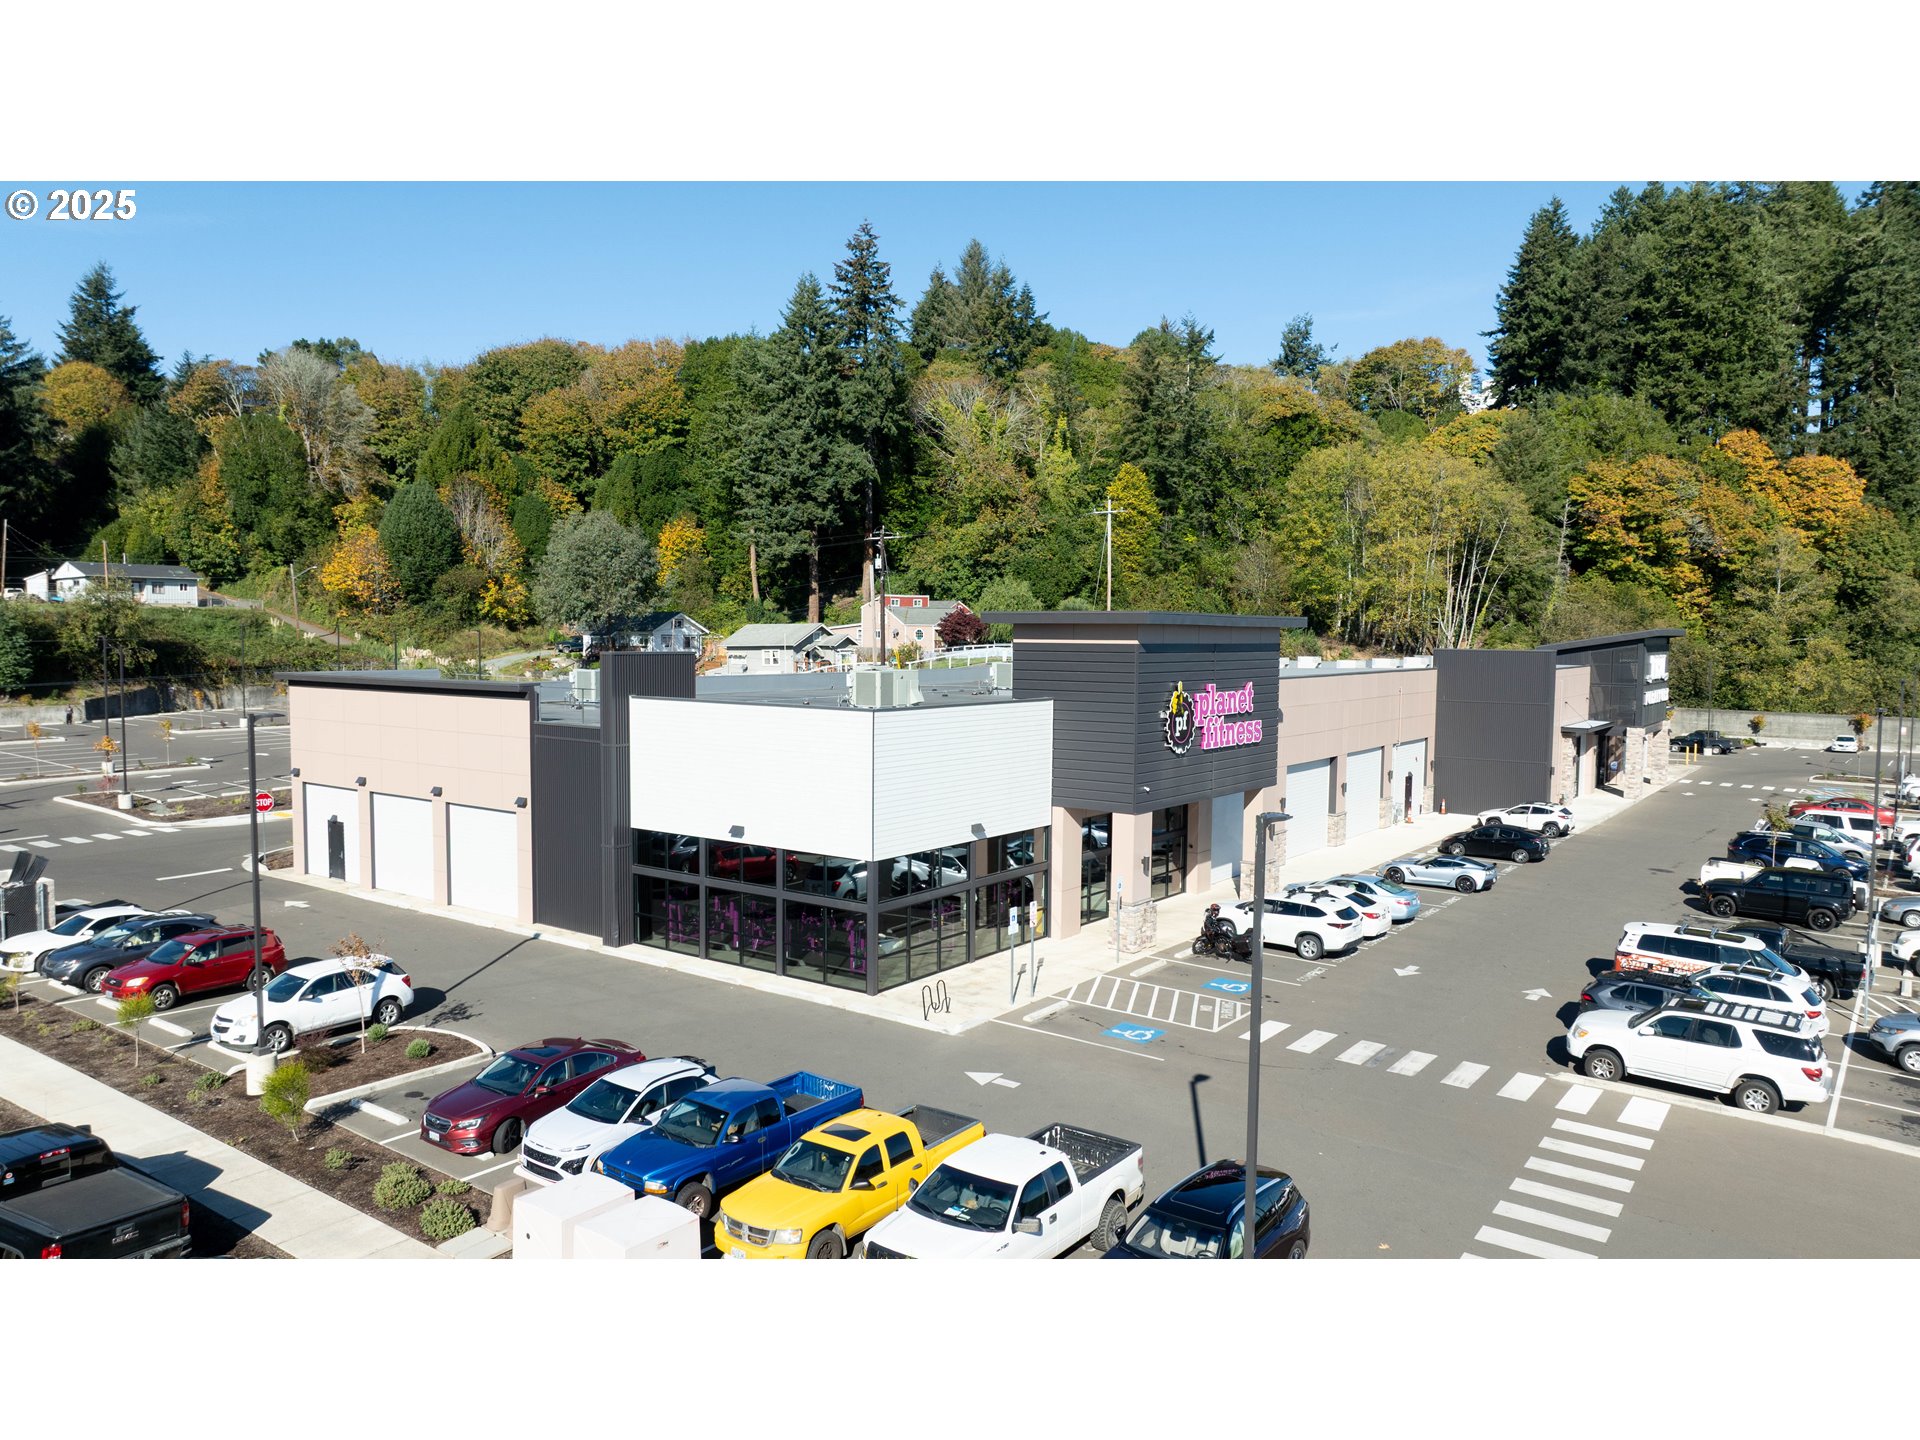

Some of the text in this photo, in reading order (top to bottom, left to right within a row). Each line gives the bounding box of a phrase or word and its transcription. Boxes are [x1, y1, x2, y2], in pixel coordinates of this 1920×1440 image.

[1194, 681, 1254, 727] planet
[1175, 710, 1188, 737] pf
[1201, 716, 1262, 750] fitness
